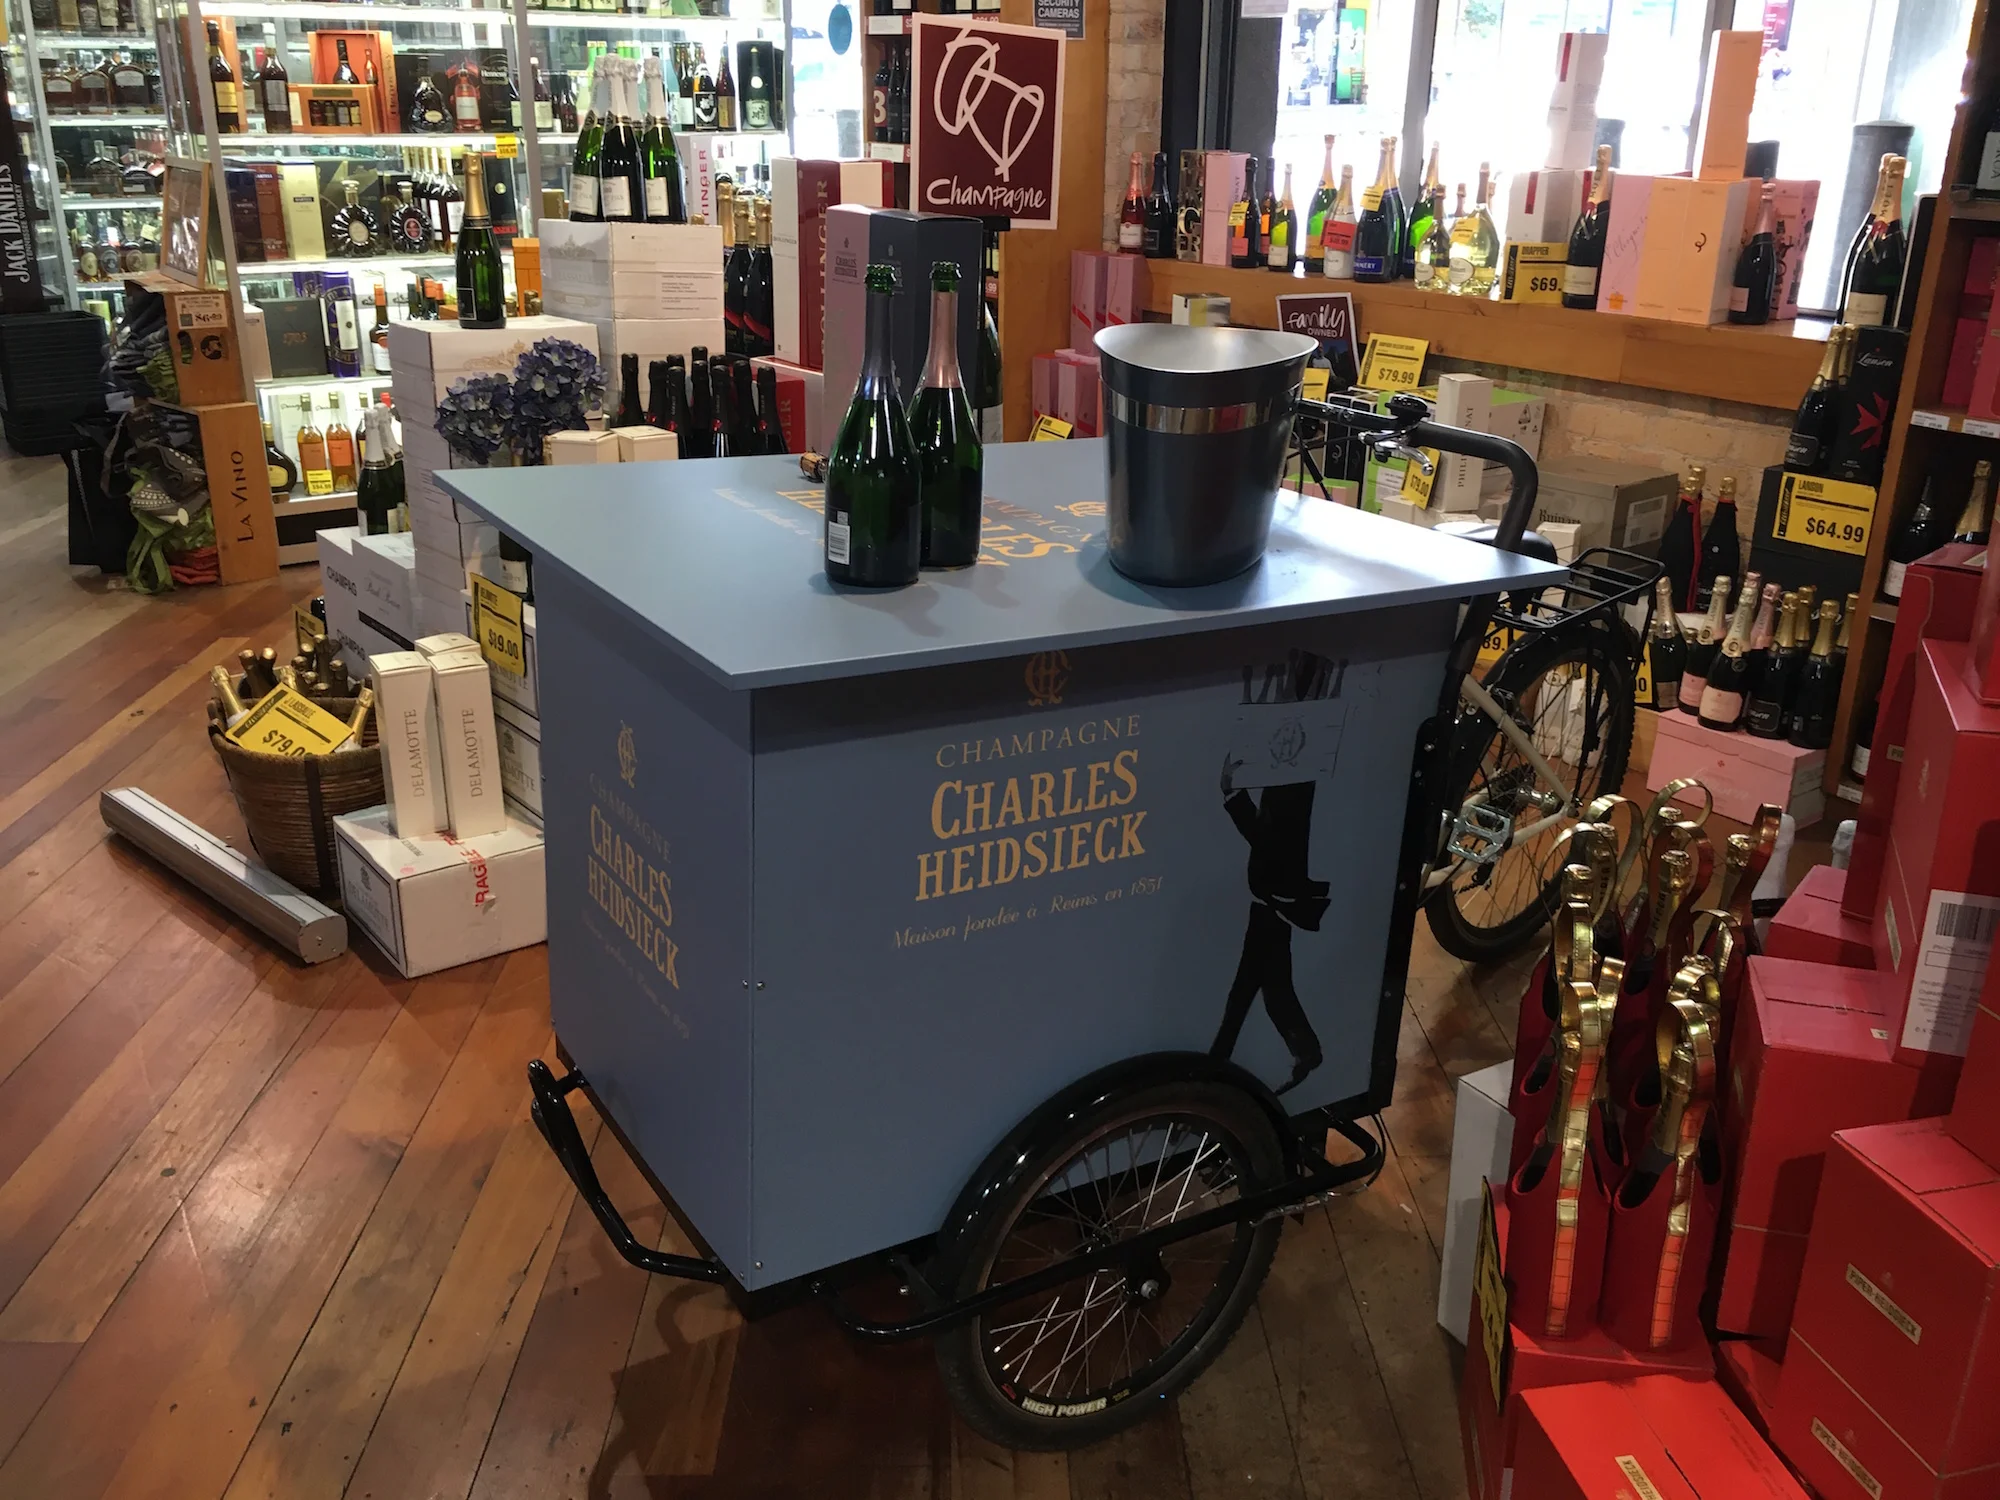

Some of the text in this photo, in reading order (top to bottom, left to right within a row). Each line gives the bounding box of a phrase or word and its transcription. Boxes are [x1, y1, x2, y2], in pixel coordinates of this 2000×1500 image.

[1038, 8, 1080, 18] CAMERAS
[4, 239, 31, 283] JACK
[1530, 277, 1562, 292] $69.
[1307, 327, 1338, 338] OWNED
[1377, 367, 1415, 385] $79.99
[230, 450, 255, 543] LA VINO
[1805, 516, 1864, 543] $64.99
[262, 728, 313, 757] $79.0
[404, 708, 425, 798] DELAMOTTE
[461, 707, 484, 798] DELAMOTTE
[936, 714, 1141, 769] CHAMPAGNE
[589, 771, 672, 864] CHAMPAGNE
[931, 749, 1139, 840] CHARLES
[590, 803, 674, 928] CHARLES
[915, 810, 1148, 902] HEIDSIECK
[587, 854, 680, 990] HEIDSIECK
[891, 922, 957, 950] Maison
[1049, 893, 1098, 914] Reims
[1105, 887, 1123, 902] en
[1130, 874, 1164, 897] 1851
[1848, 1267, 1918, 1339] PIPER-HEIDSIECK
[1020, 1396, 1109, 1418] HIGH POWER
[1813, 1421, 1879, 1495] PIPER-HEIDSIECK
